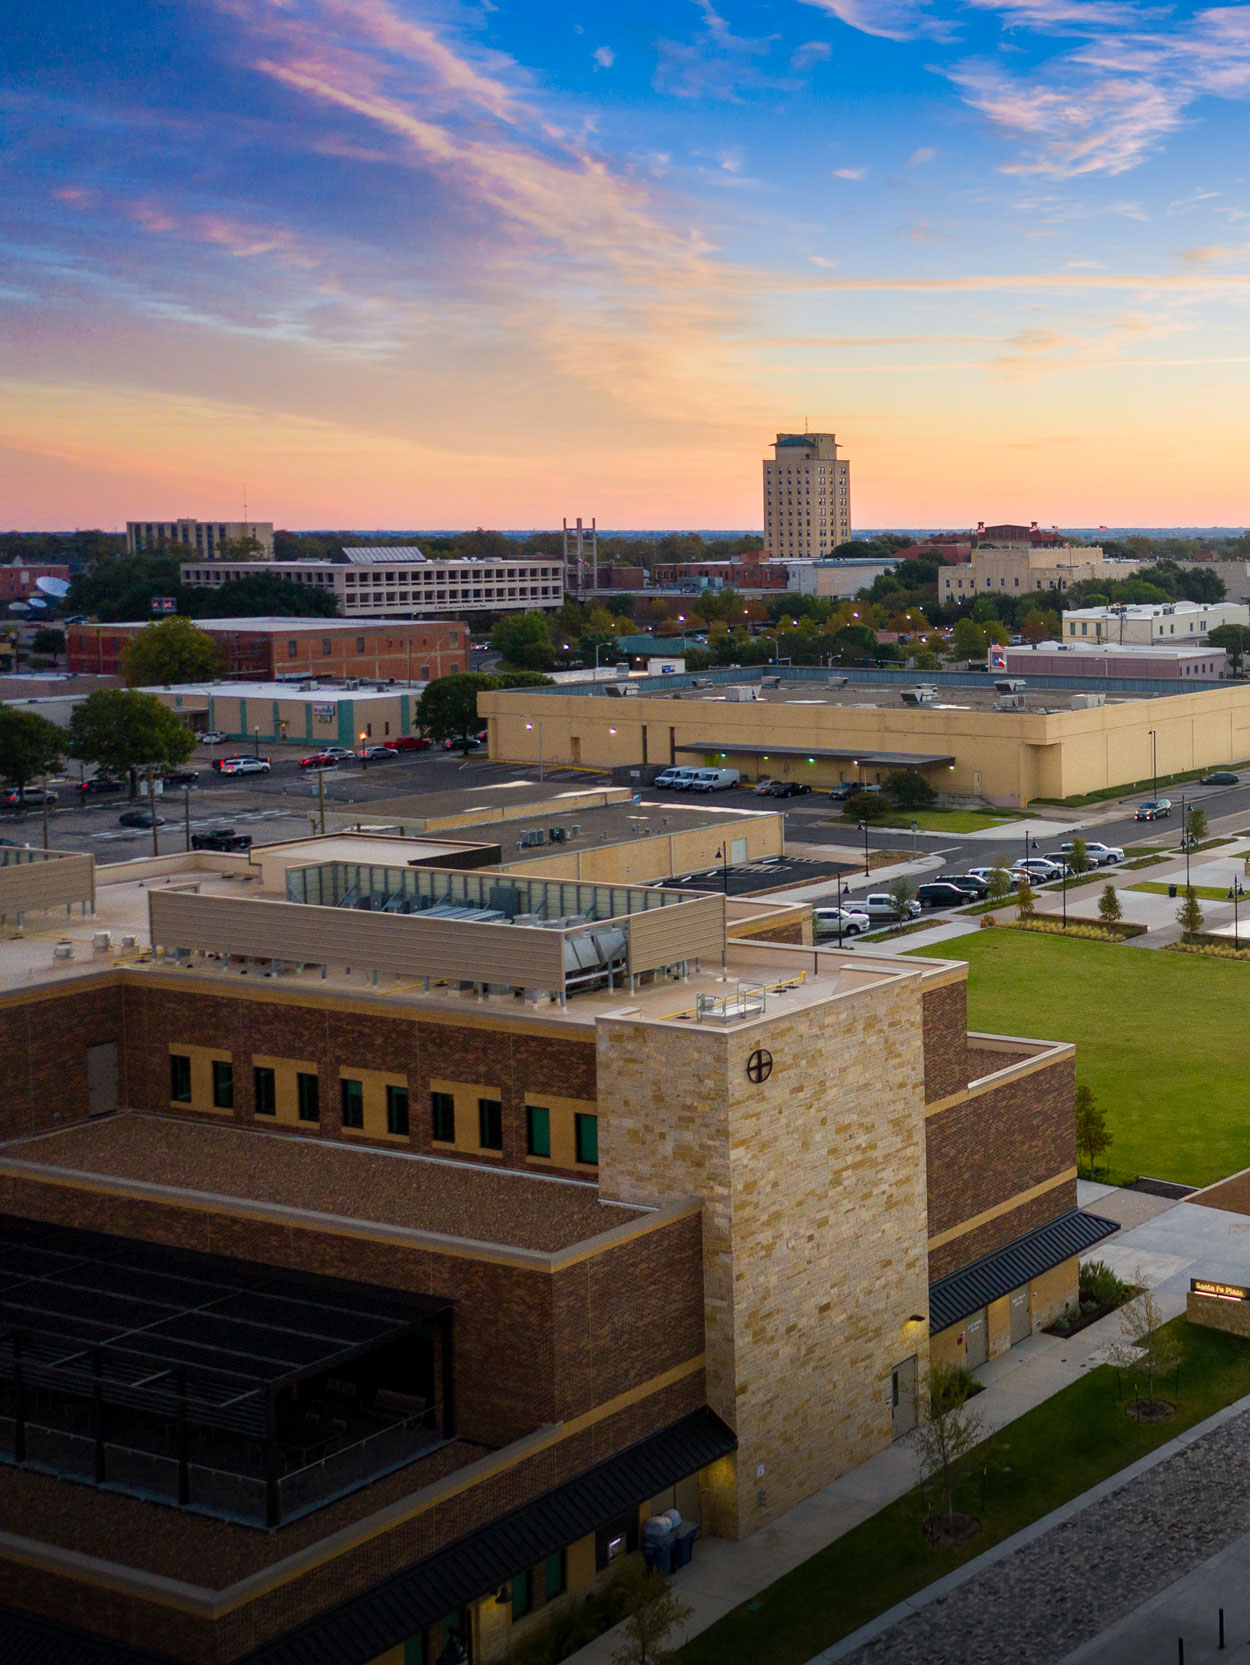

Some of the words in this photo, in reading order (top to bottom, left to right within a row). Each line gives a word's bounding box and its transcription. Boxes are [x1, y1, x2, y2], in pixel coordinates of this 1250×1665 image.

[1196, 1282, 1214, 1292] Santa
[1216, 1285, 1224, 1293] Fe
[1225, 1287, 1244, 1297] Plaza
